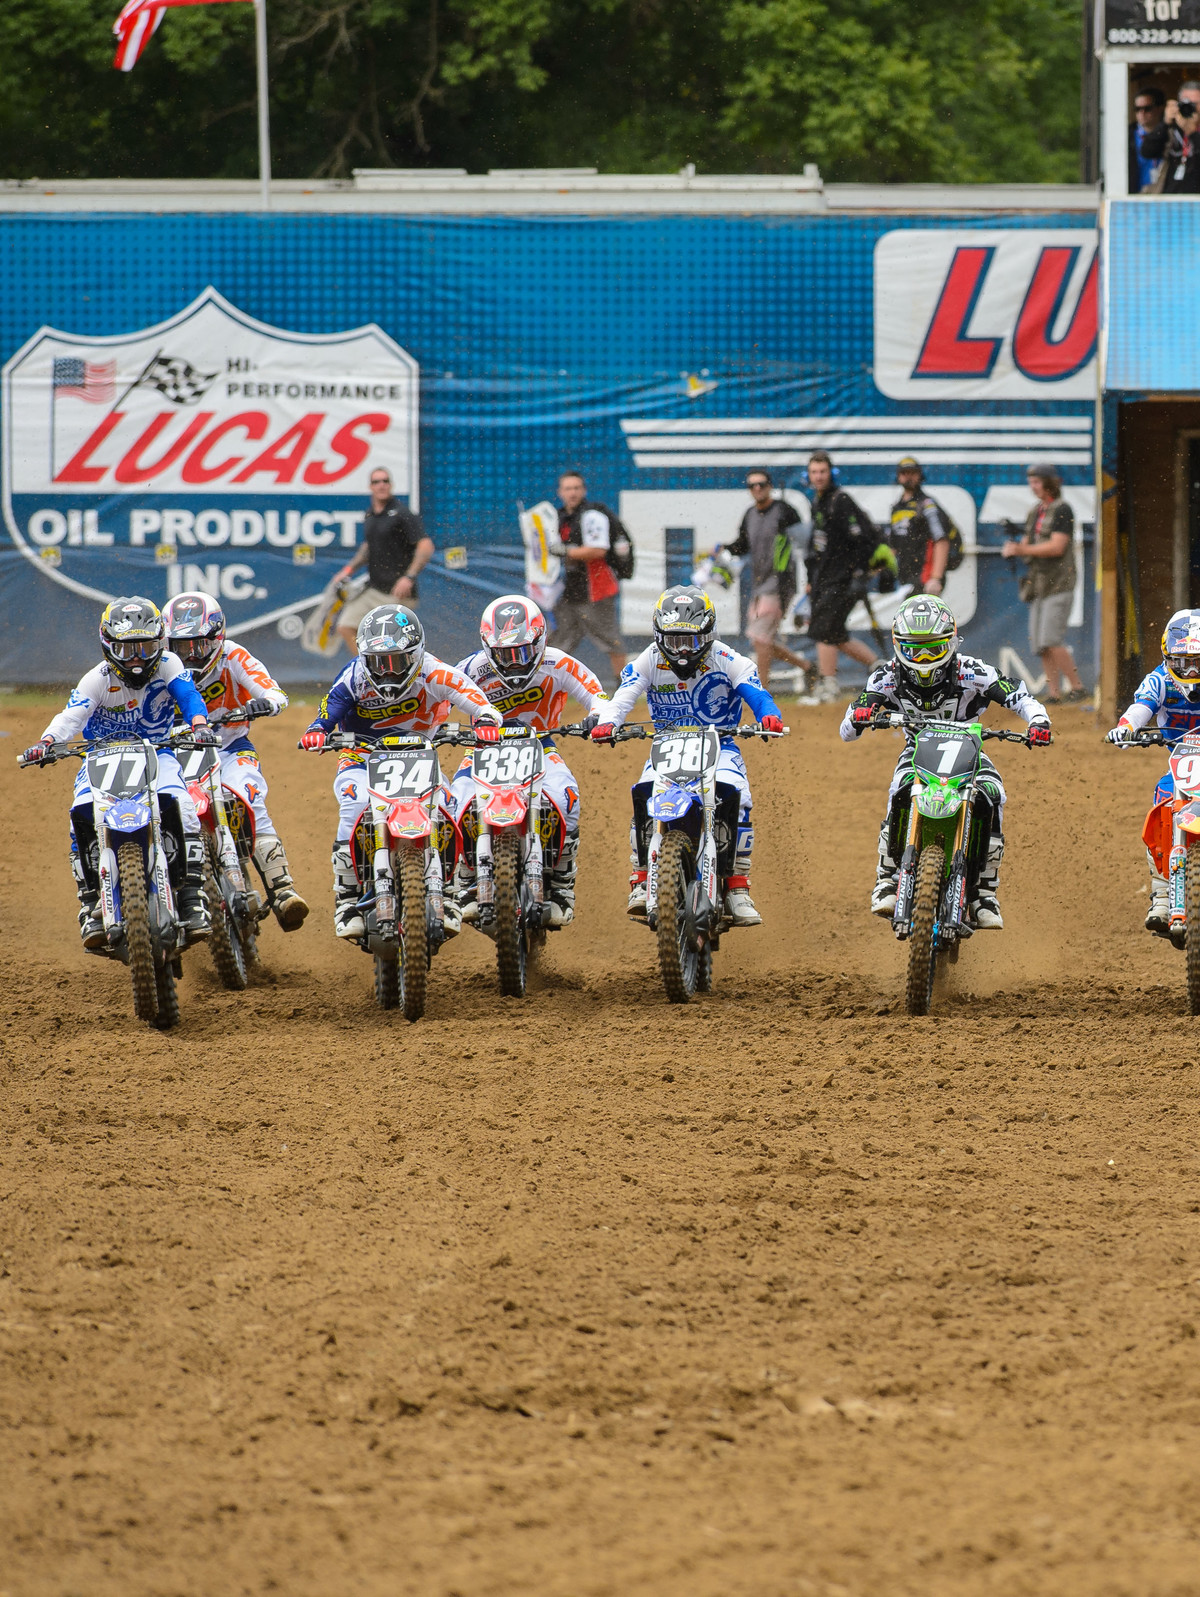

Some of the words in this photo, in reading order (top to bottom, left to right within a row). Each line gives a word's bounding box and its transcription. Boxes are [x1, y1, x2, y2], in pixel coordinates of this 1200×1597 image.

[1144, 0, 1181, 22] for
[226, 356, 258, 374] HI-
[226, 381, 402, 401] PERFORMANCE
[53, 410, 391, 486] LUCAS
[27, 509, 114, 547] OIL
[131, 508, 367, 547] PRODUCT
[166, 562, 269, 600] INC.
[357, 698, 419, 720] GEICO
[491, 686, 543, 713] EICO
[105, 747, 125, 756] LUCAS
[409, 751, 419, 759] OIL
[477, 746, 537, 785] 338
[656, 737, 711, 775] 38
[936, 740, 964, 774] 1
[95, 752, 148, 791] 77
[374, 759, 434, 797] 34
[157, 865, 168, 905] UNLOP
[951, 874, 961, 923] DUNLOP
[1169, 857, 1177, 909] DNLOP
[1176, 867, 1185, 907] MOTOREX
